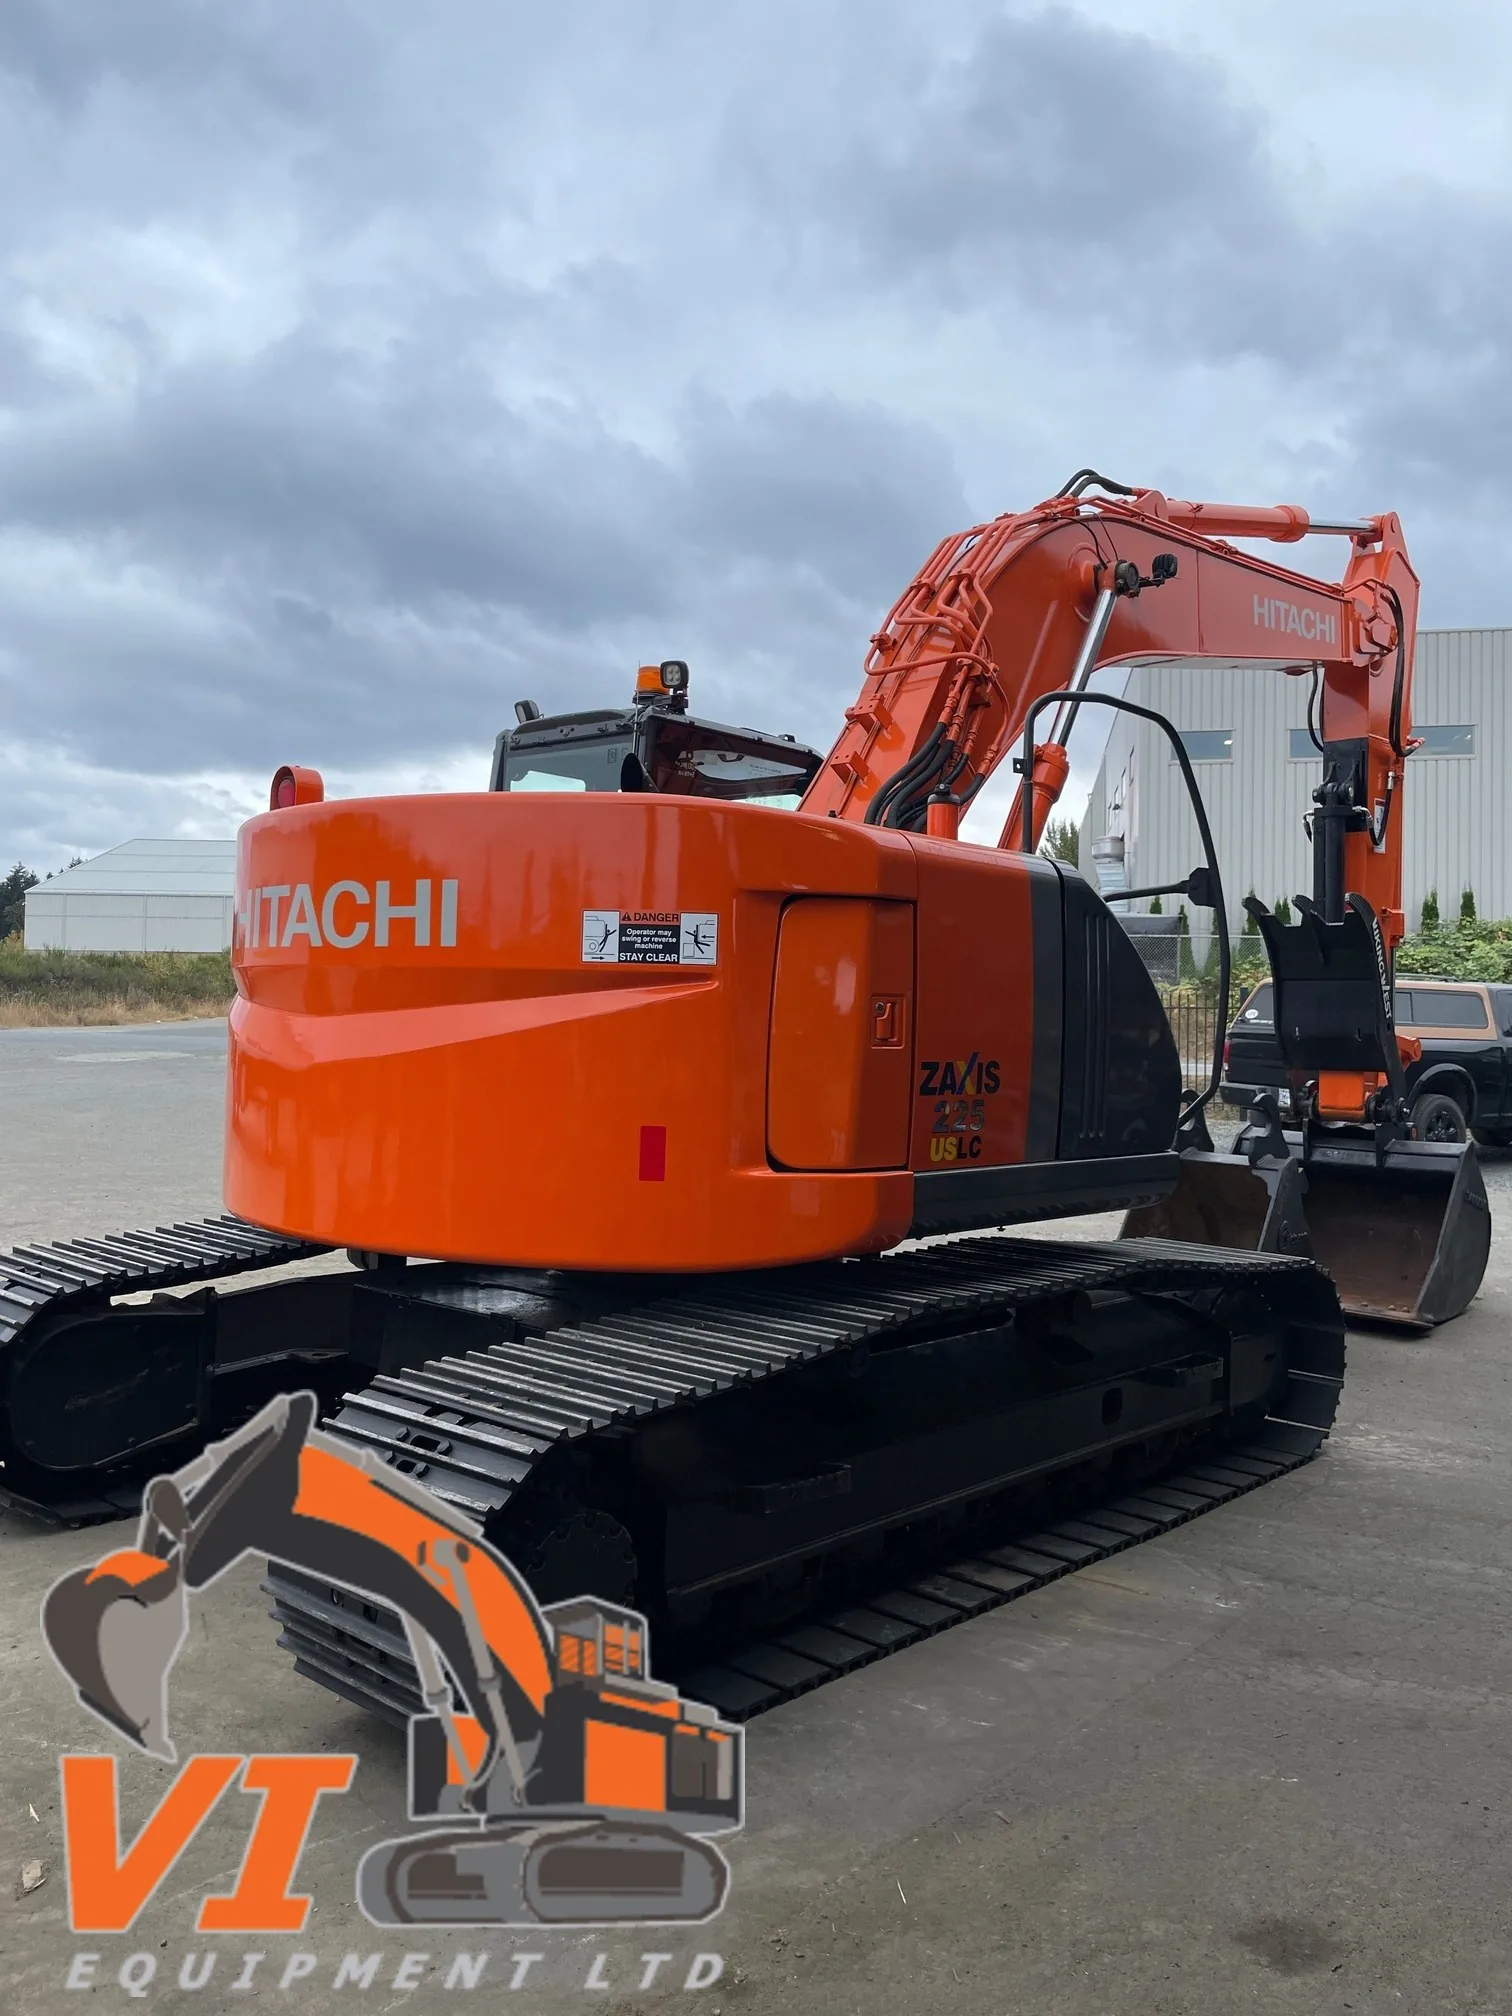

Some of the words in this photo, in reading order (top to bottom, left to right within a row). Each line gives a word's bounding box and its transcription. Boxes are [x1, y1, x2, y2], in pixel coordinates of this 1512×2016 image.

[1253, 594, 1336, 644] HITACHI
[235, 879, 459, 949] HITACHI
[633, 912, 679, 922] DANGER
[621, 935, 641, 943] swing
[626, 928, 656, 936] Operator
[619, 952, 644, 961] STAY
[645, 953, 678, 962] CLEAR
[920, 1052, 1000, 1096] ZAXIS
[932, 1100, 985, 1134] 225
[930, 1135, 982, 1162] USLC
